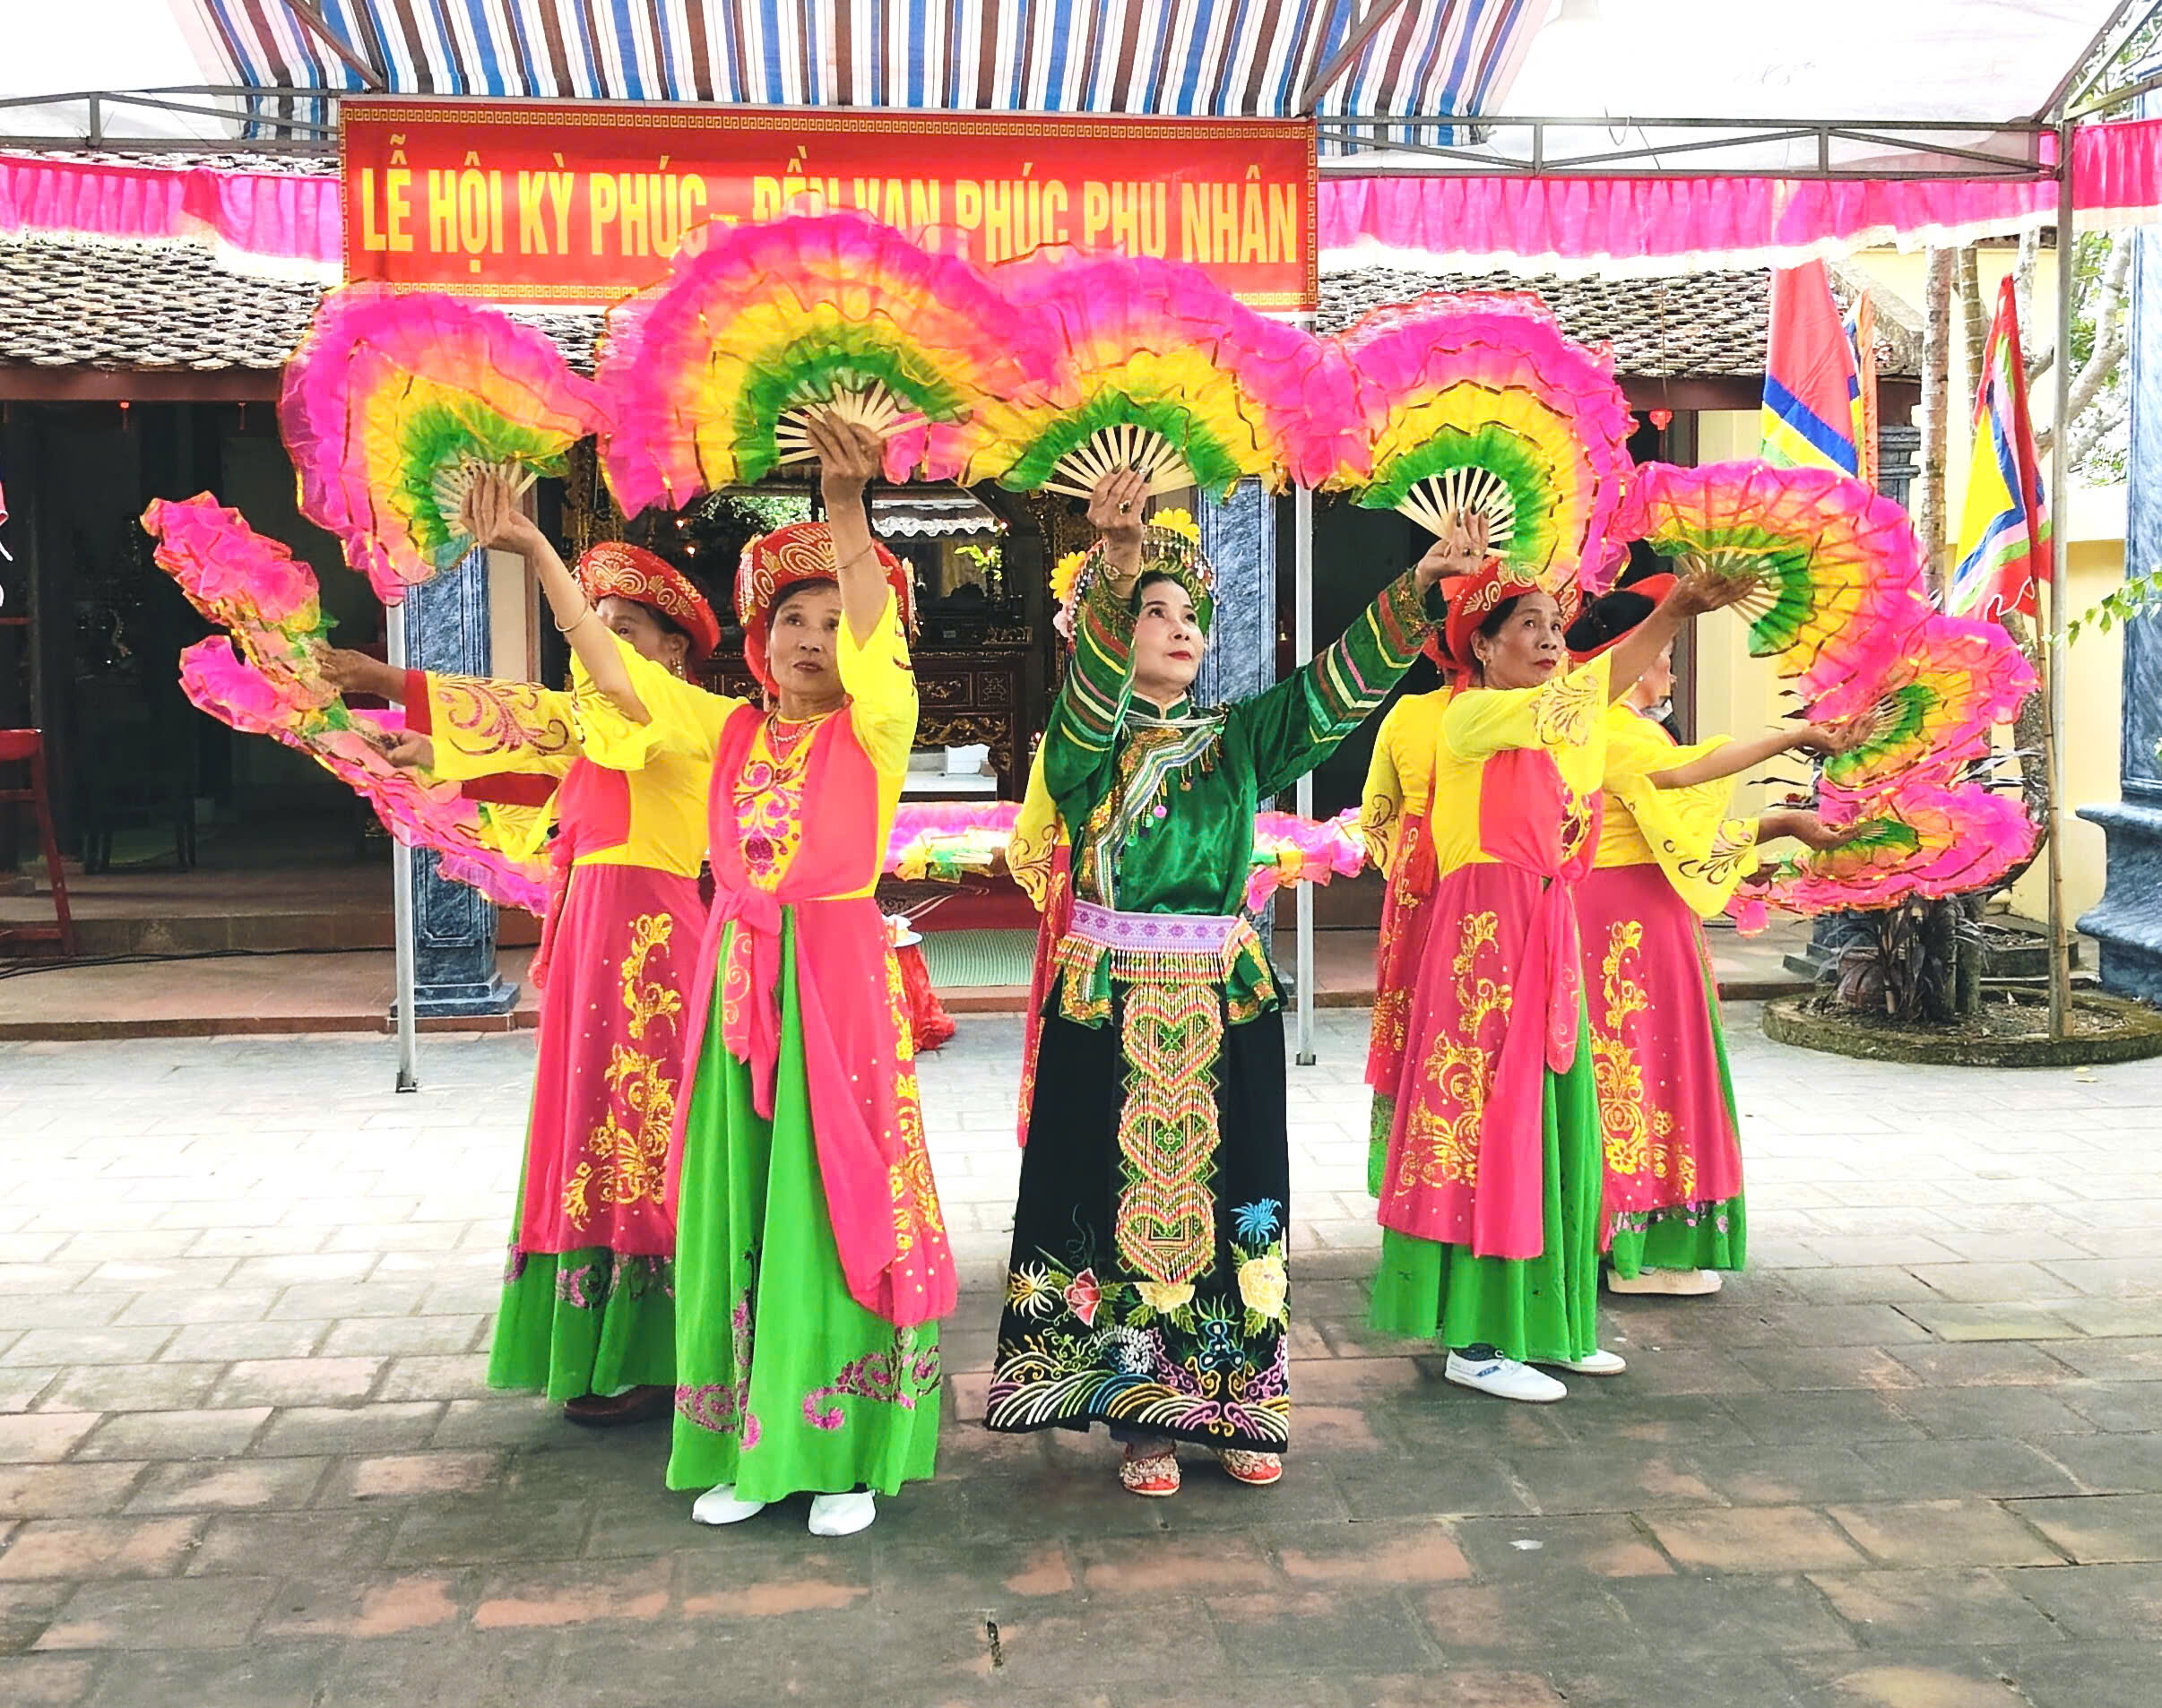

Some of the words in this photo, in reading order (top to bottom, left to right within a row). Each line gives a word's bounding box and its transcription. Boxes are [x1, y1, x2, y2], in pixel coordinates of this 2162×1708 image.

[361, 134, 414, 252] LỄ
[428, 151, 505, 273] HỘI
[517, 152, 575, 255] KỲ
[590, 155, 708, 258] PHÚC
[956, 161, 1068, 263] PHÚC
[1180, 165, 1297, 263] NHÂN
